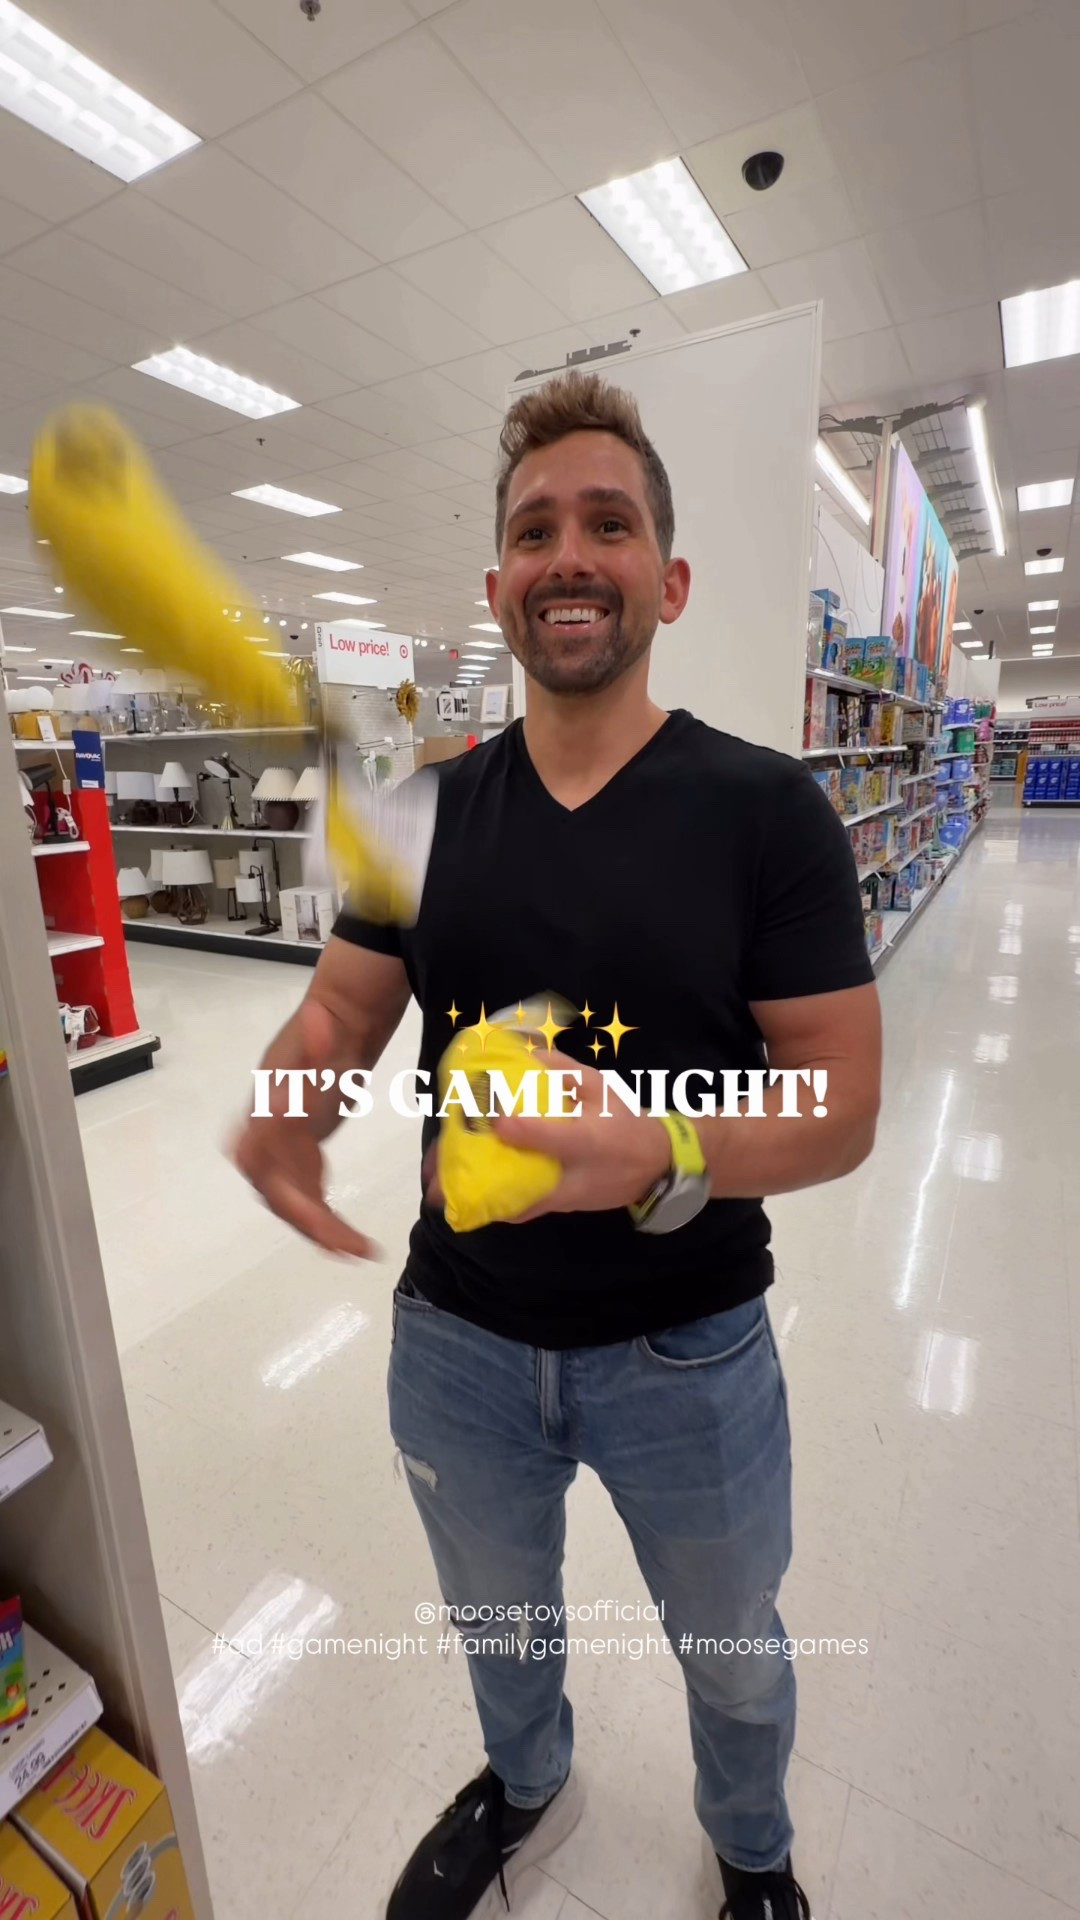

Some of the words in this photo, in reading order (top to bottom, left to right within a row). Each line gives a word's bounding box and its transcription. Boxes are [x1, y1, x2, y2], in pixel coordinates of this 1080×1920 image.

[330, 634, 355, 652] Low
[359, 640, 389, 656] price!
[14, 1753, 46, 1789] 24.99
